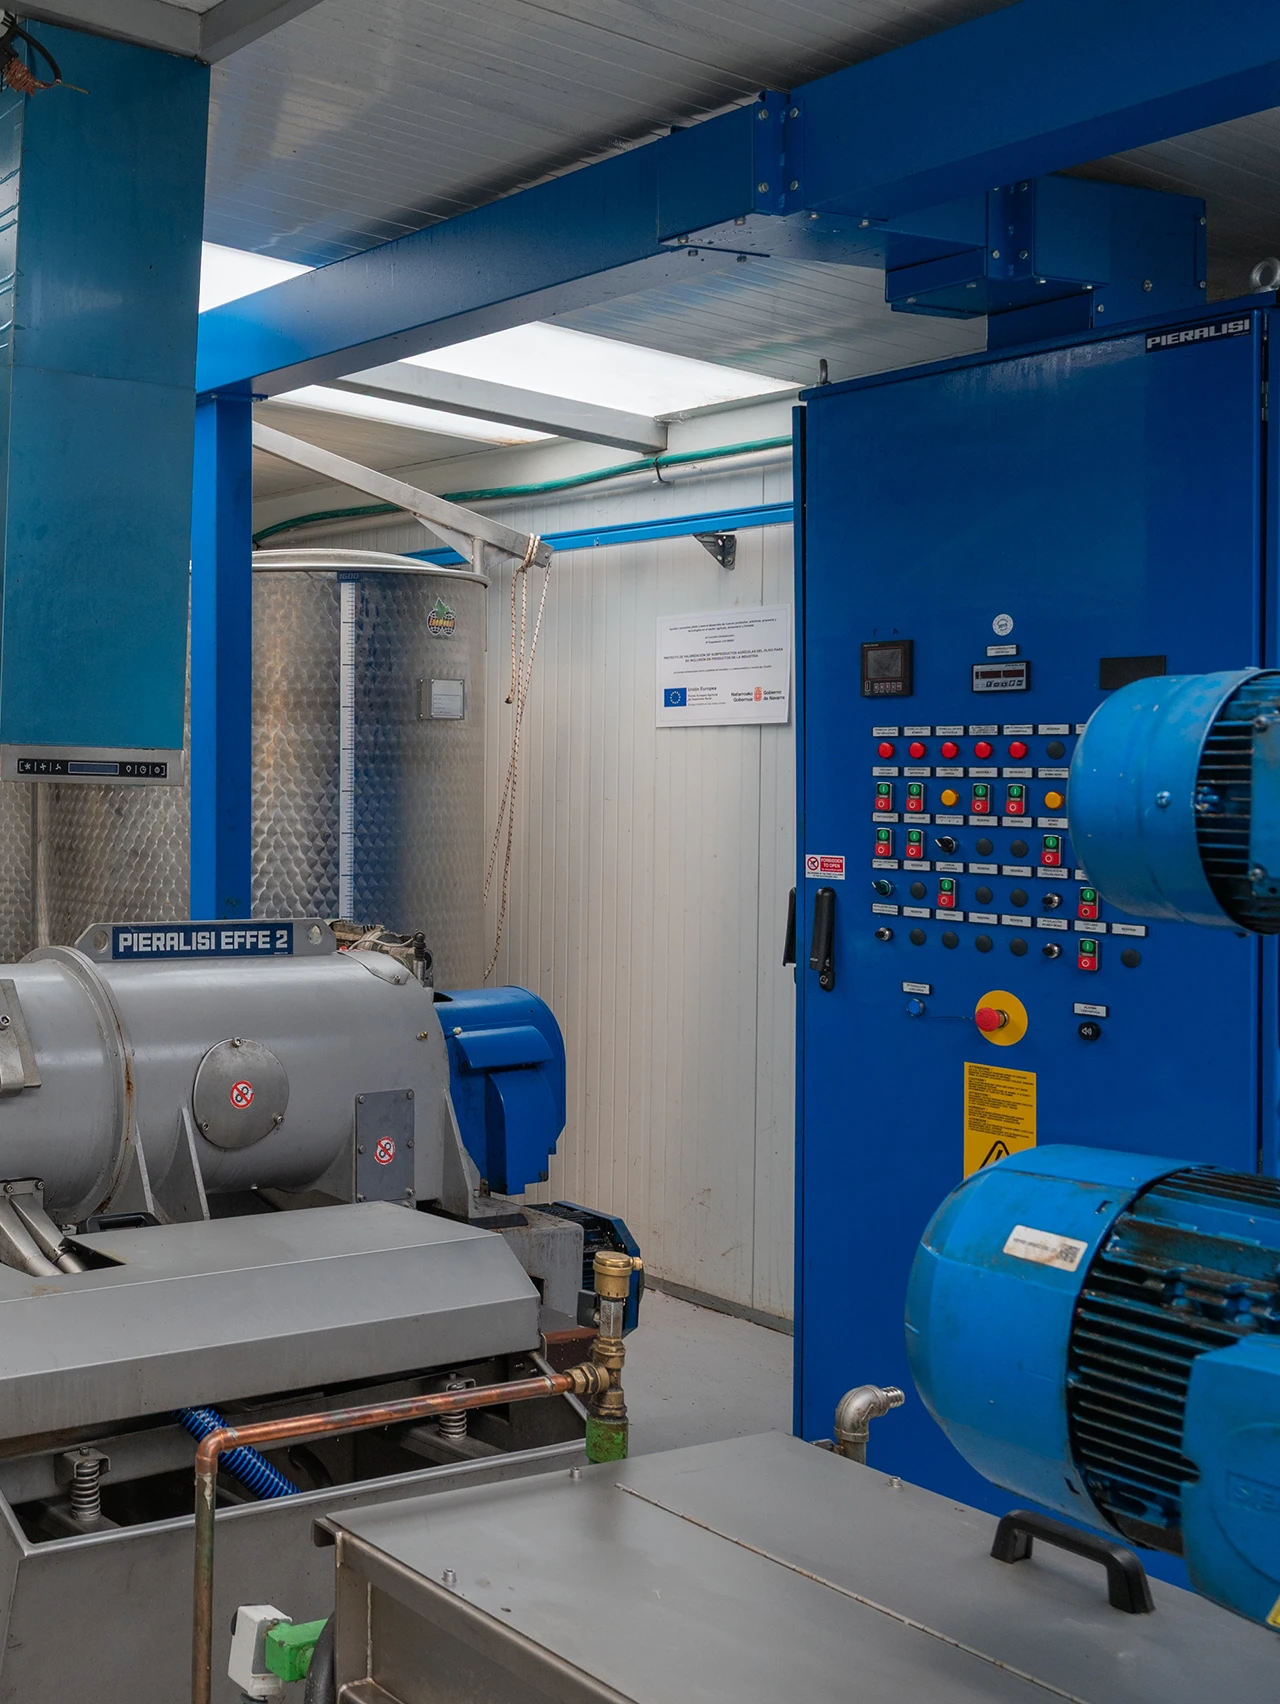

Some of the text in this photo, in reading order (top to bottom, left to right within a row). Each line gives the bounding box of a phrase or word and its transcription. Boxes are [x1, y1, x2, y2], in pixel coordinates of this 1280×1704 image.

[1146, 319, 1250, 348] PIERALISI
[118, 930, 287, 952] PIERALISI EFFE 2
